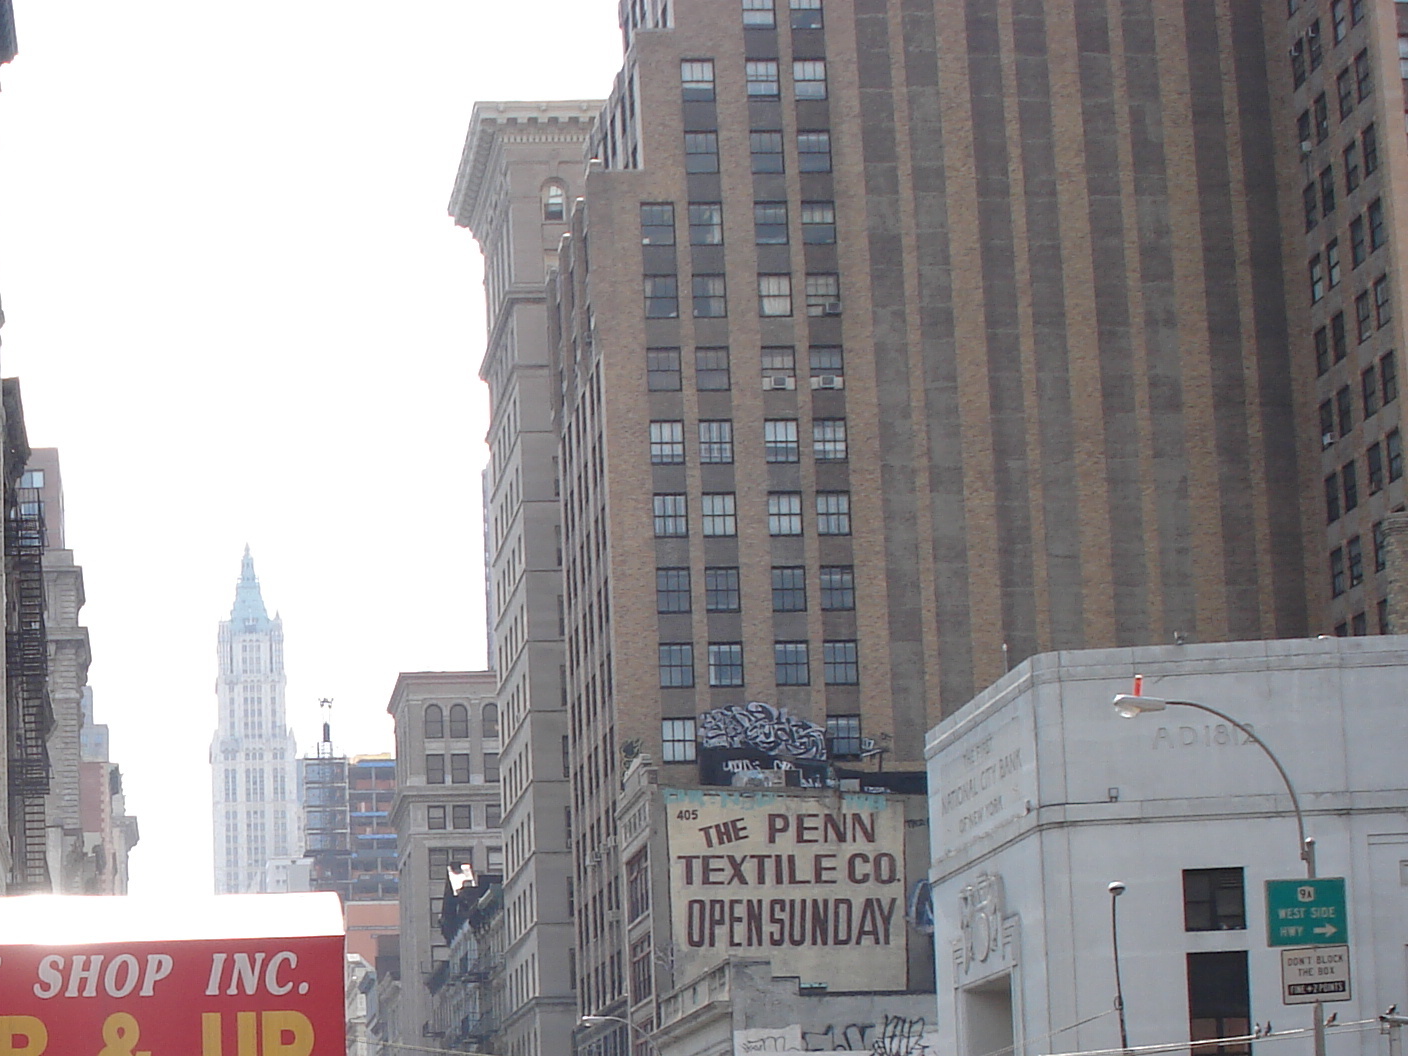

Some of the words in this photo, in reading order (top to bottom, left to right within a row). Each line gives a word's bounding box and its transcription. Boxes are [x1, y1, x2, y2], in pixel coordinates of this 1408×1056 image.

[677, 809, 698, 821] 405
[698, 818, 749, 849] THE
[768, 812, 875, 844] PENN
[677, 853, 838, 886] TEXTILE
[847, 852, 901, 885] CO.
[1299, 889, 1313, 899] 9A
[1278, 908, 1306, 919] WEST
[1310, 907, 1336, 918] SIDE
[687, 898, 763, 948] OPEN
[769, 897, 897, 947] SUNDAY
[1279, 926, 1304, 937] HWY
[1287, 956, 1312, 966] DON'T
[1316, 954, 1344, 965] BLOCK
[33, 952, 174, 1000] SHOP
[205, 950, 309, 997] INC.
[1298, 968, 1314, 977] THE
[1318, 966, 1335, 976] BOX
